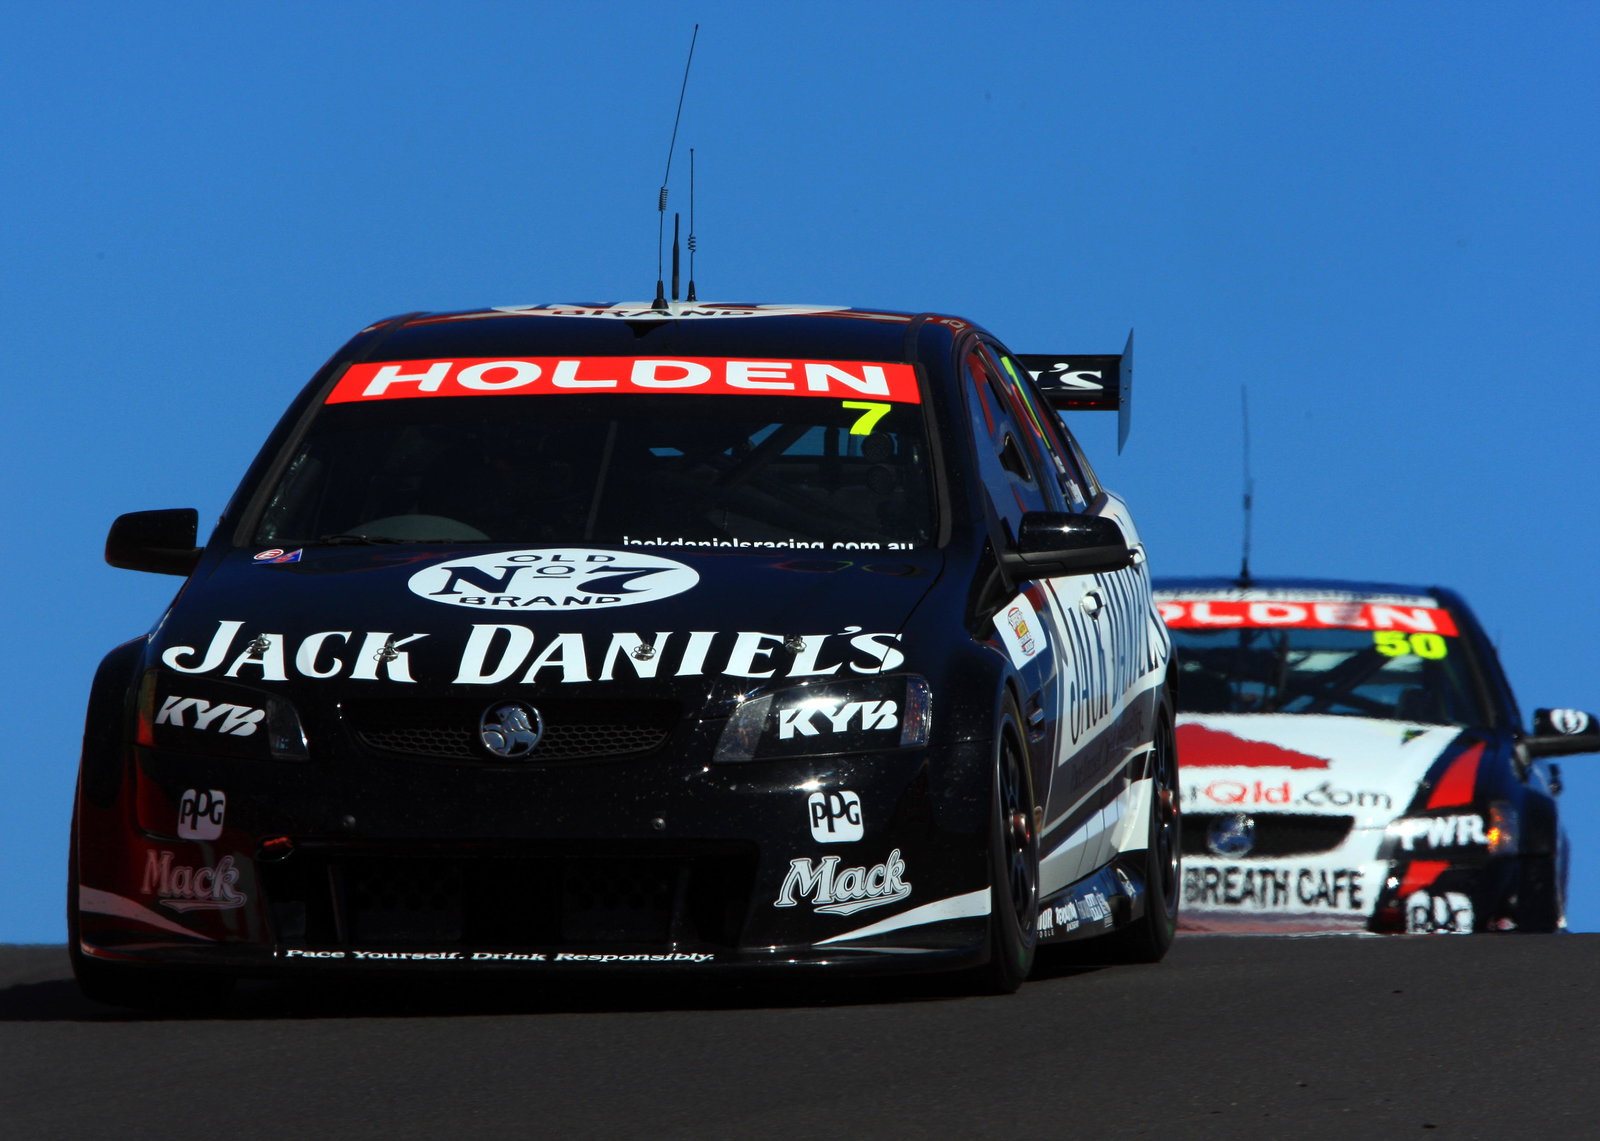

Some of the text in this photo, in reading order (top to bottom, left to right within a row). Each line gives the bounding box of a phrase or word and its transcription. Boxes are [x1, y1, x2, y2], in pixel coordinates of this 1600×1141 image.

[362, 359, 890, 397] HOLDEN
[841, 401, 892, 435] 7
[506, 554, 616, 563] OLD
[576, 565, 681, 595] 7
[458, 595, 622, 607] BRAND
[162, 620, 905, 686] JACK DANIEL'S
[1374, 630, 1448, 660] 50
[155, 695, 267, 737] KYB
[779, 699, 899, 740] KYB
[179, 788, 226, 838] PPG
[809, 790, 863, 838] PPG
[141, 848, 248, 914] Mack
[774, 848, 912, 916] Mack
[1185, 866, 1290, 910] BREATH
[1299, 868, 1365, 910] CAFE
[285, 949, 715, 963] Pace Yourself. Drink Responsibly.
